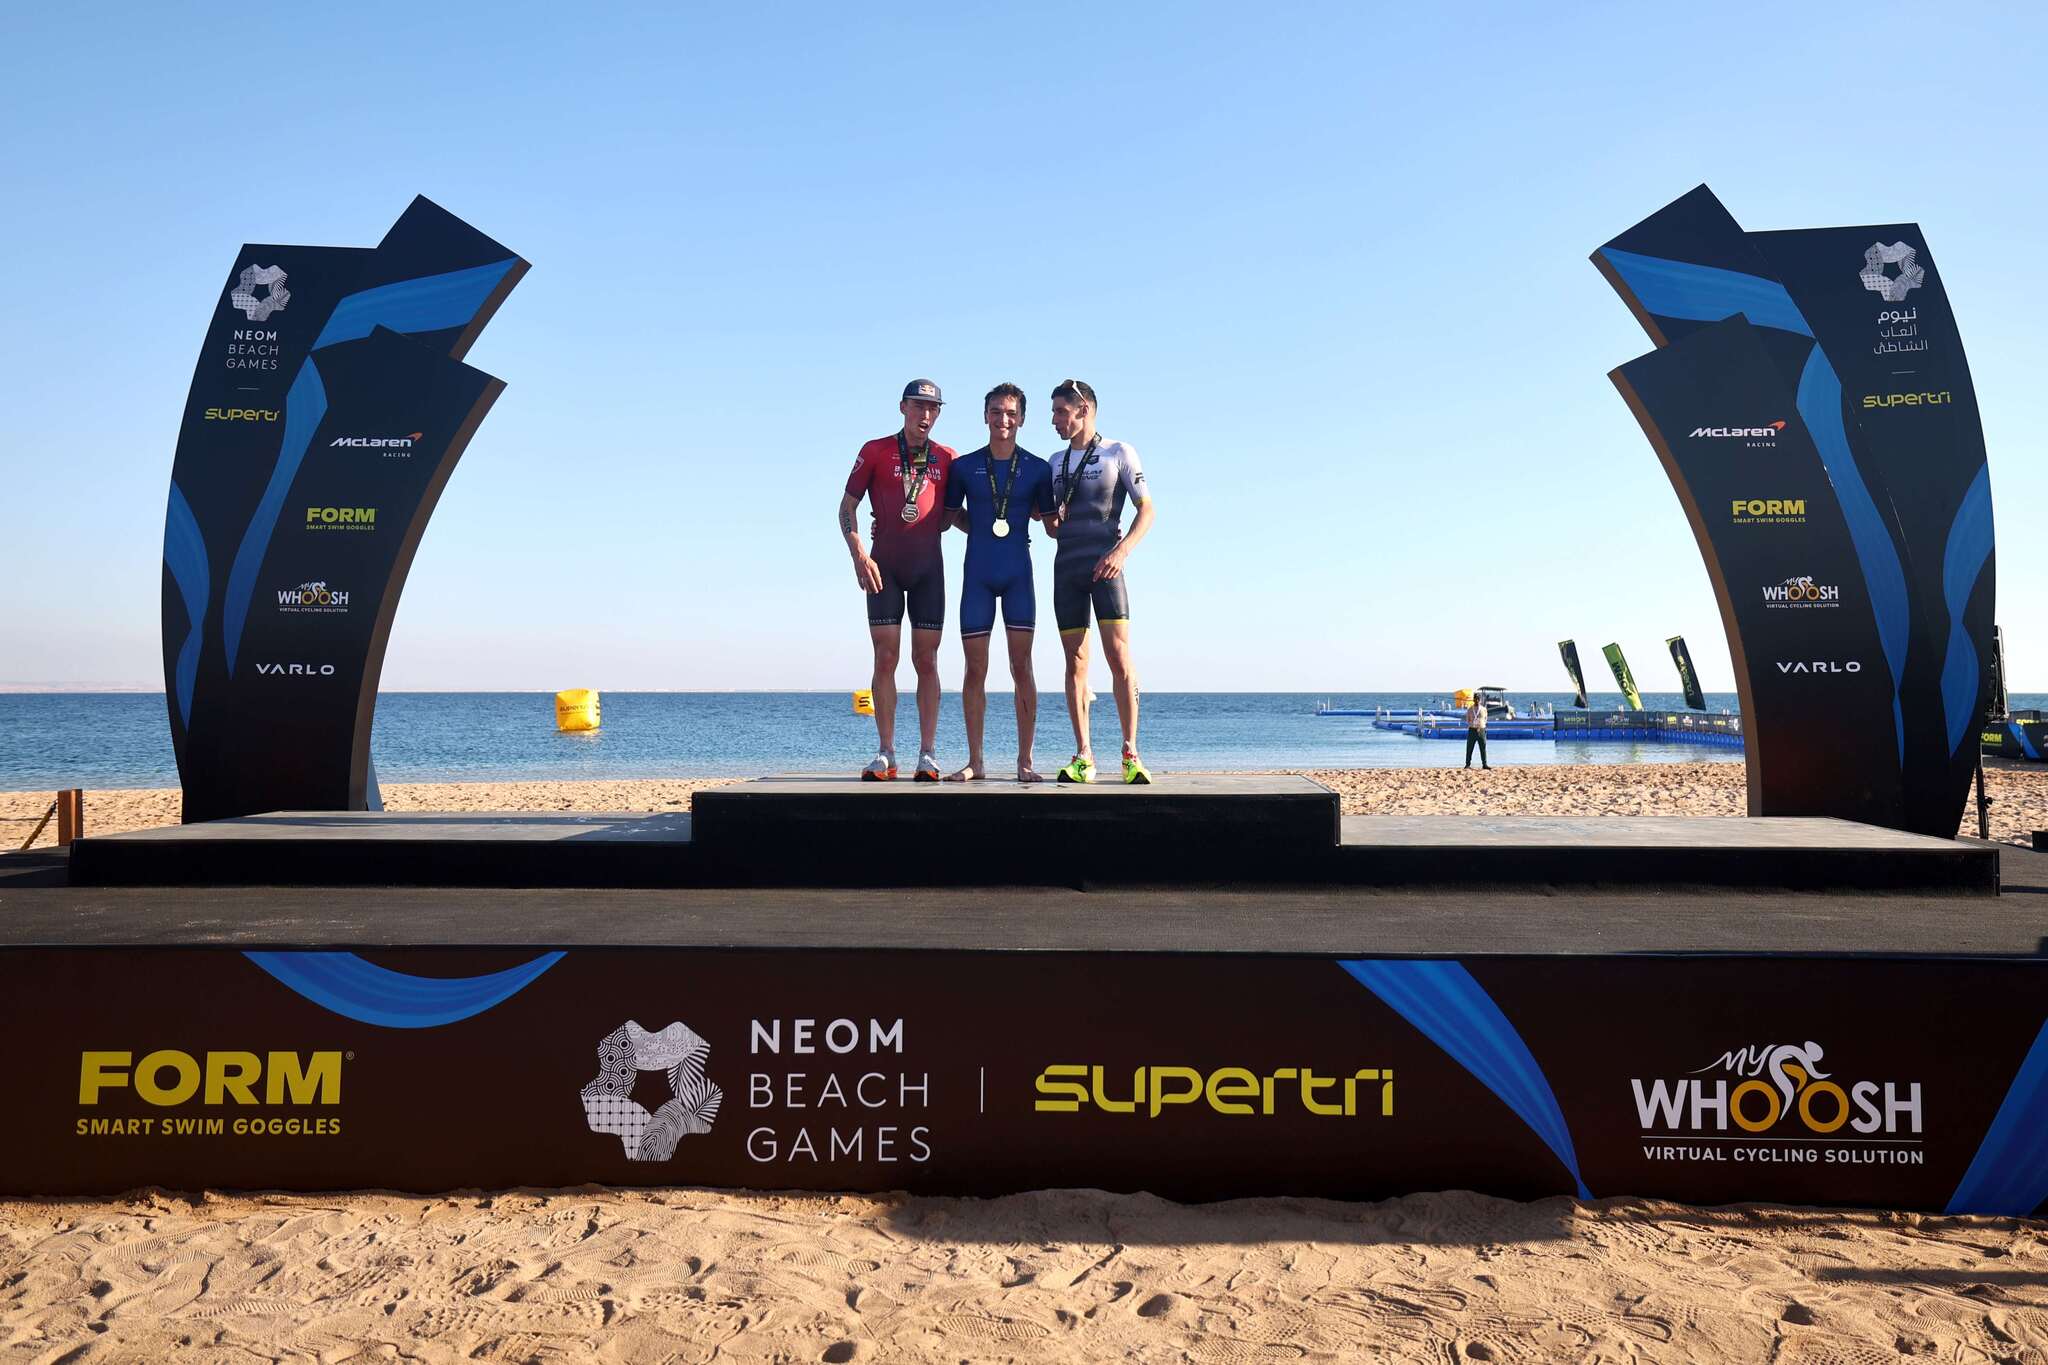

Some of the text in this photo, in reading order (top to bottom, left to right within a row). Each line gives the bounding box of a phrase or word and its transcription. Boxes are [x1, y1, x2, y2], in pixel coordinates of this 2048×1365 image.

[1877, 306, 1917, 325] نيوم
[233, 329, 277, 342] NEOM
[228, 343, 279, 356] BEACH
[226, 358, 278, 370] GAMES
[1863, 391, 1951, 408] supertri
[1688, 427, 1776, 438] McLaren
[329, 437, 412, 448] McLaren
[306, 507, 376, 523] FORM
[1732, 499, 1805, 516] FORM
[277, 590, 349, 605] WHOOSH
[1763, 586, 1839, 601] WHOOSH
[255, 663, 335, 676] VARLO
[1776, 661, 1861, 673] VARLO
[750, 1018, 904, 1054] NEOM
[749, 1072, 928, 1108] BEACH
[1034, 1064, 1394, 1118] supertri
[1630, 1078, 1923, 1133] WHOOSH
[76, 1118, 341, 1136] SMART SWIM GOGGLES
[746, 1126, 931, 1163] GAMES
[1643, 1146, 1924, 1165] VIRTUAL CYCLING SOLUTION
